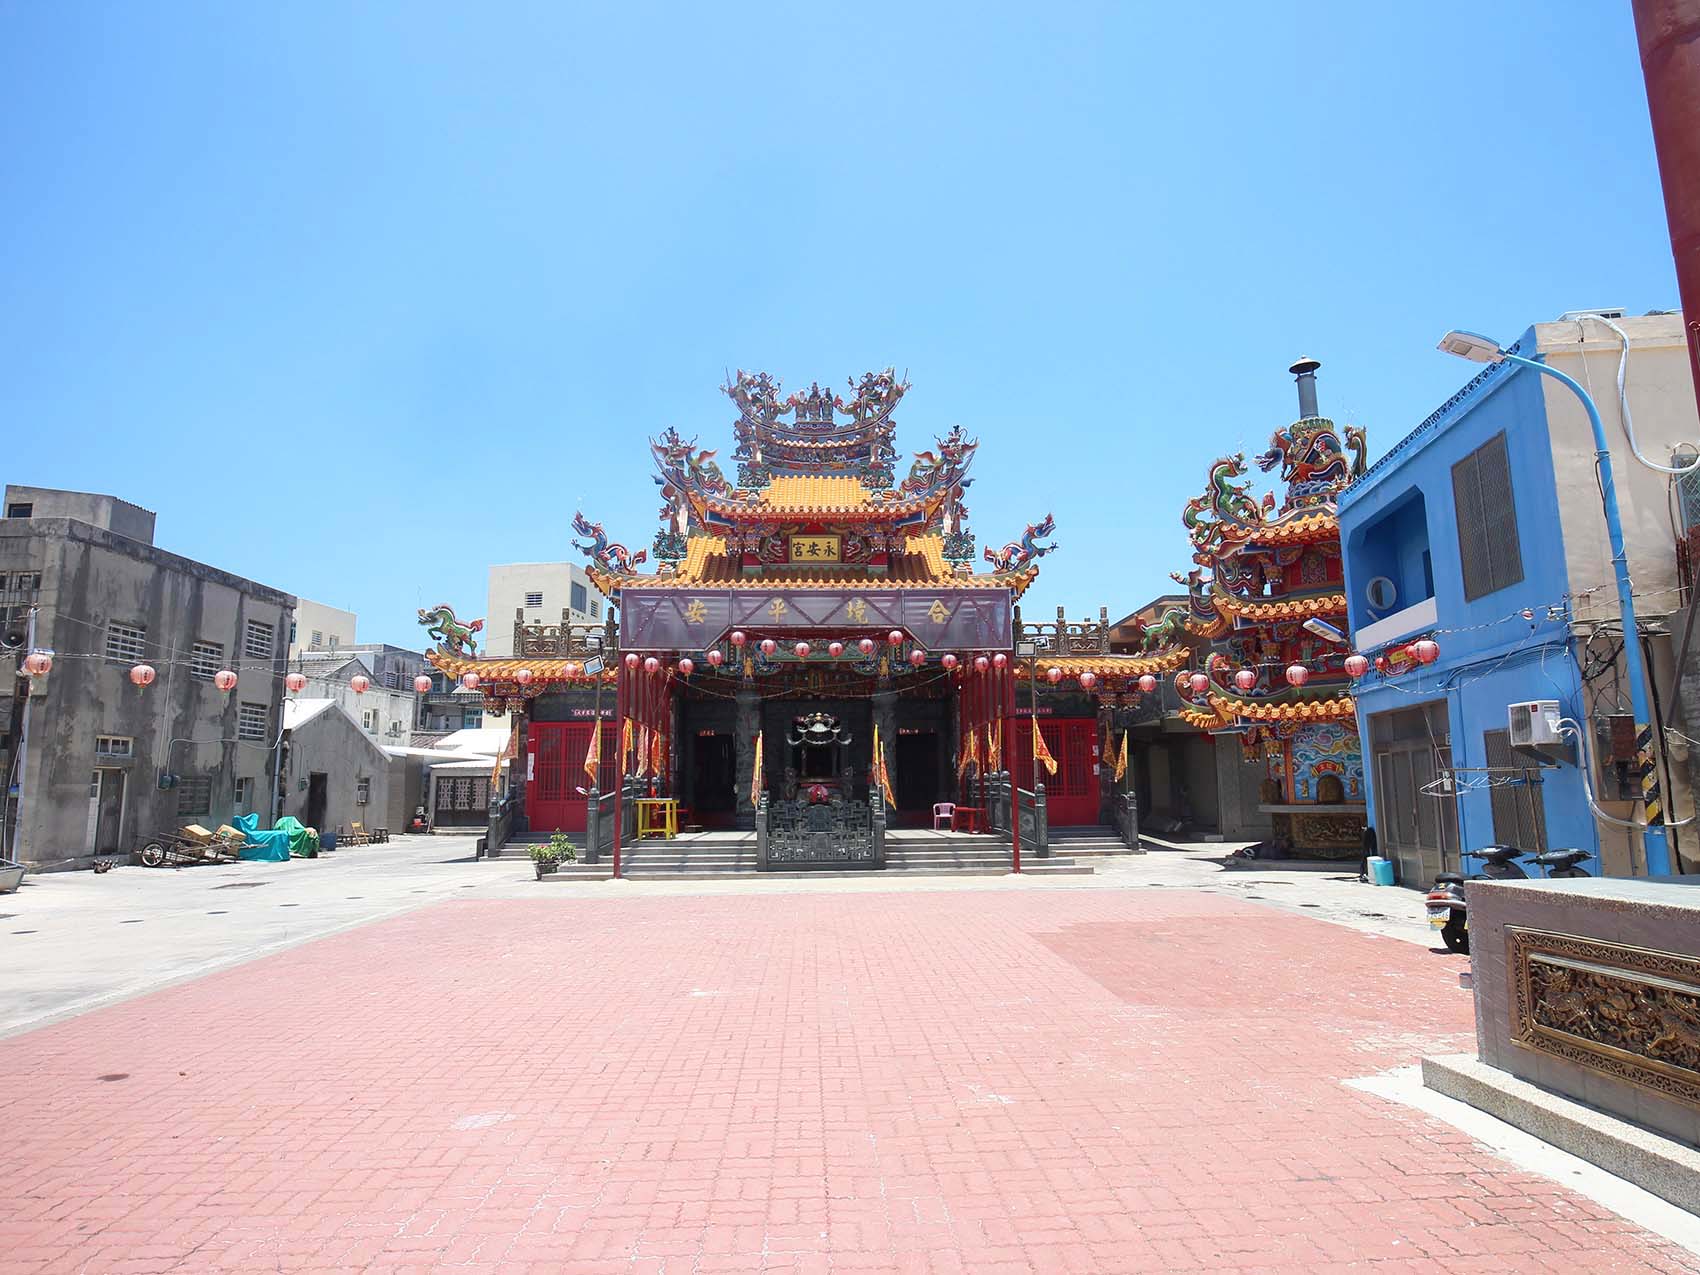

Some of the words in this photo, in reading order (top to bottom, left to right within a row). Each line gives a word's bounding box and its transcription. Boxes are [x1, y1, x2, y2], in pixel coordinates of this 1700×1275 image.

[792, 541, 837, 557] 永安宮
[684, 598, 951, 624] 合境平安
